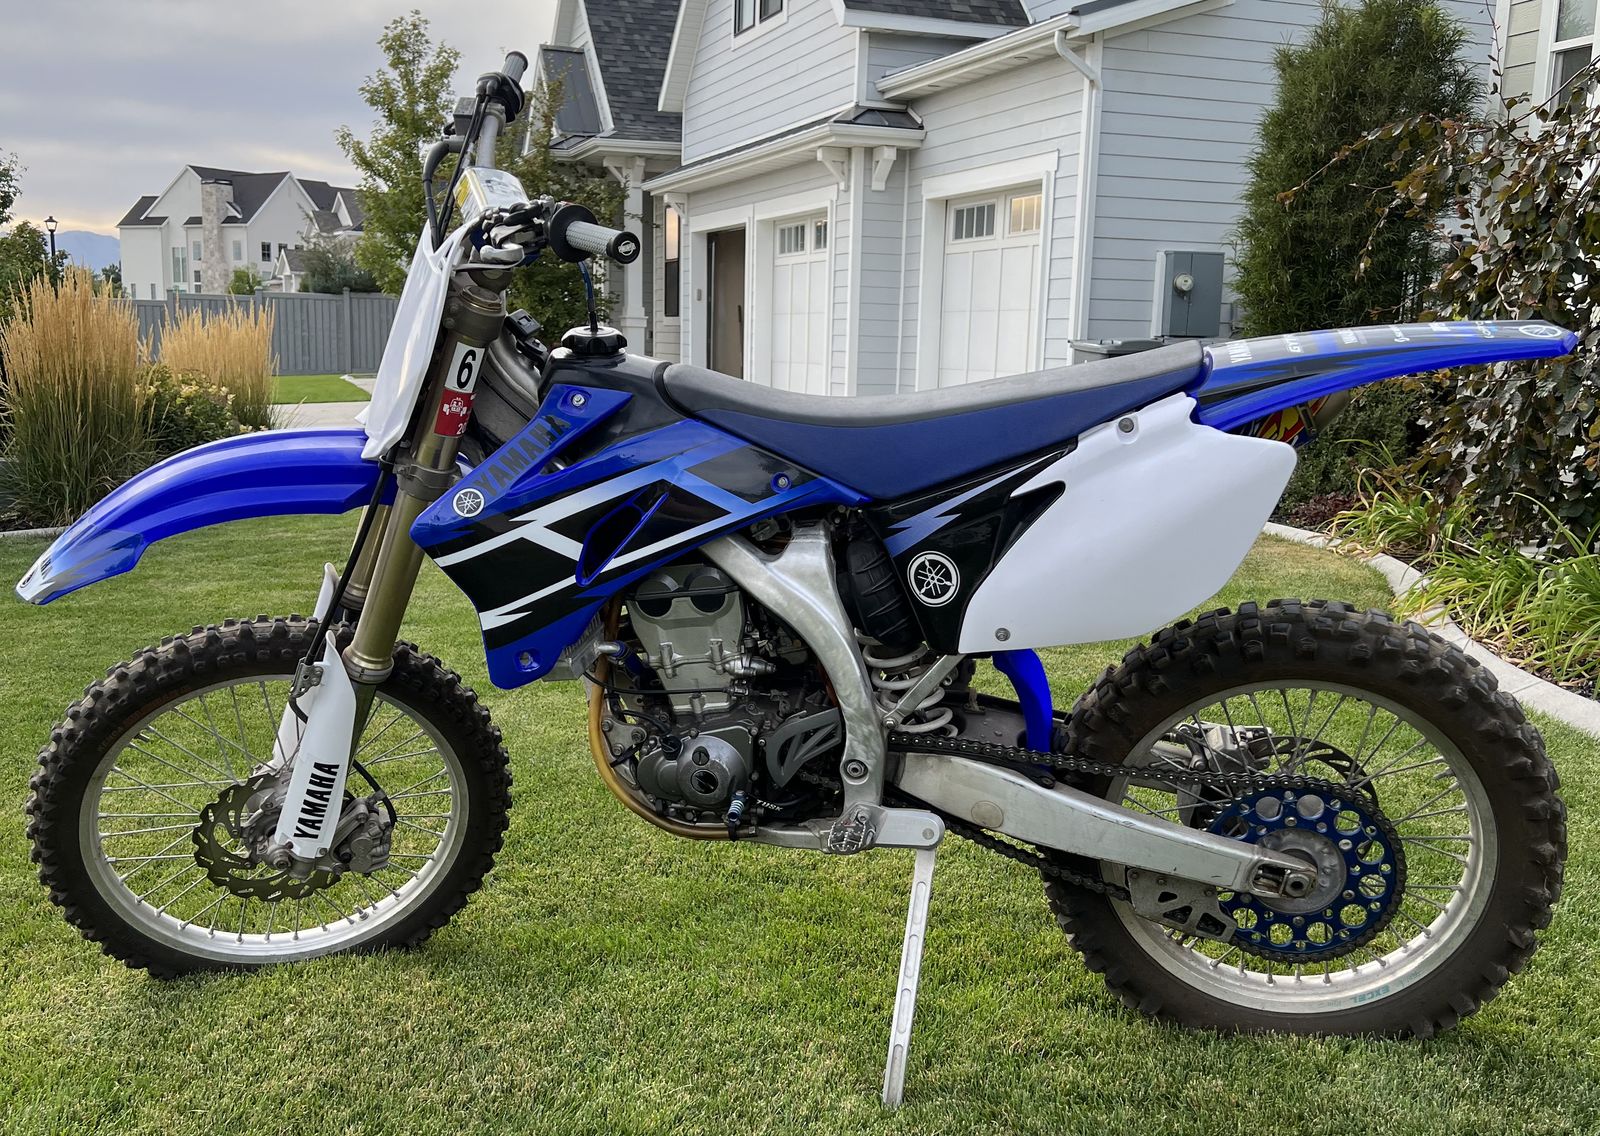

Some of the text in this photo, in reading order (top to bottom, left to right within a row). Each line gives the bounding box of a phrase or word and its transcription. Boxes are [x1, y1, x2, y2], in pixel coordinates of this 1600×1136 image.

[456, 349, 477, 389] 6
[472, 414, 572, 497] YAMAHA
[293, 761, 340, 840] YAMAHA
[756, 798, 784, 811] TUSK
[1350, 984, 1391, 1003] EXCEL
